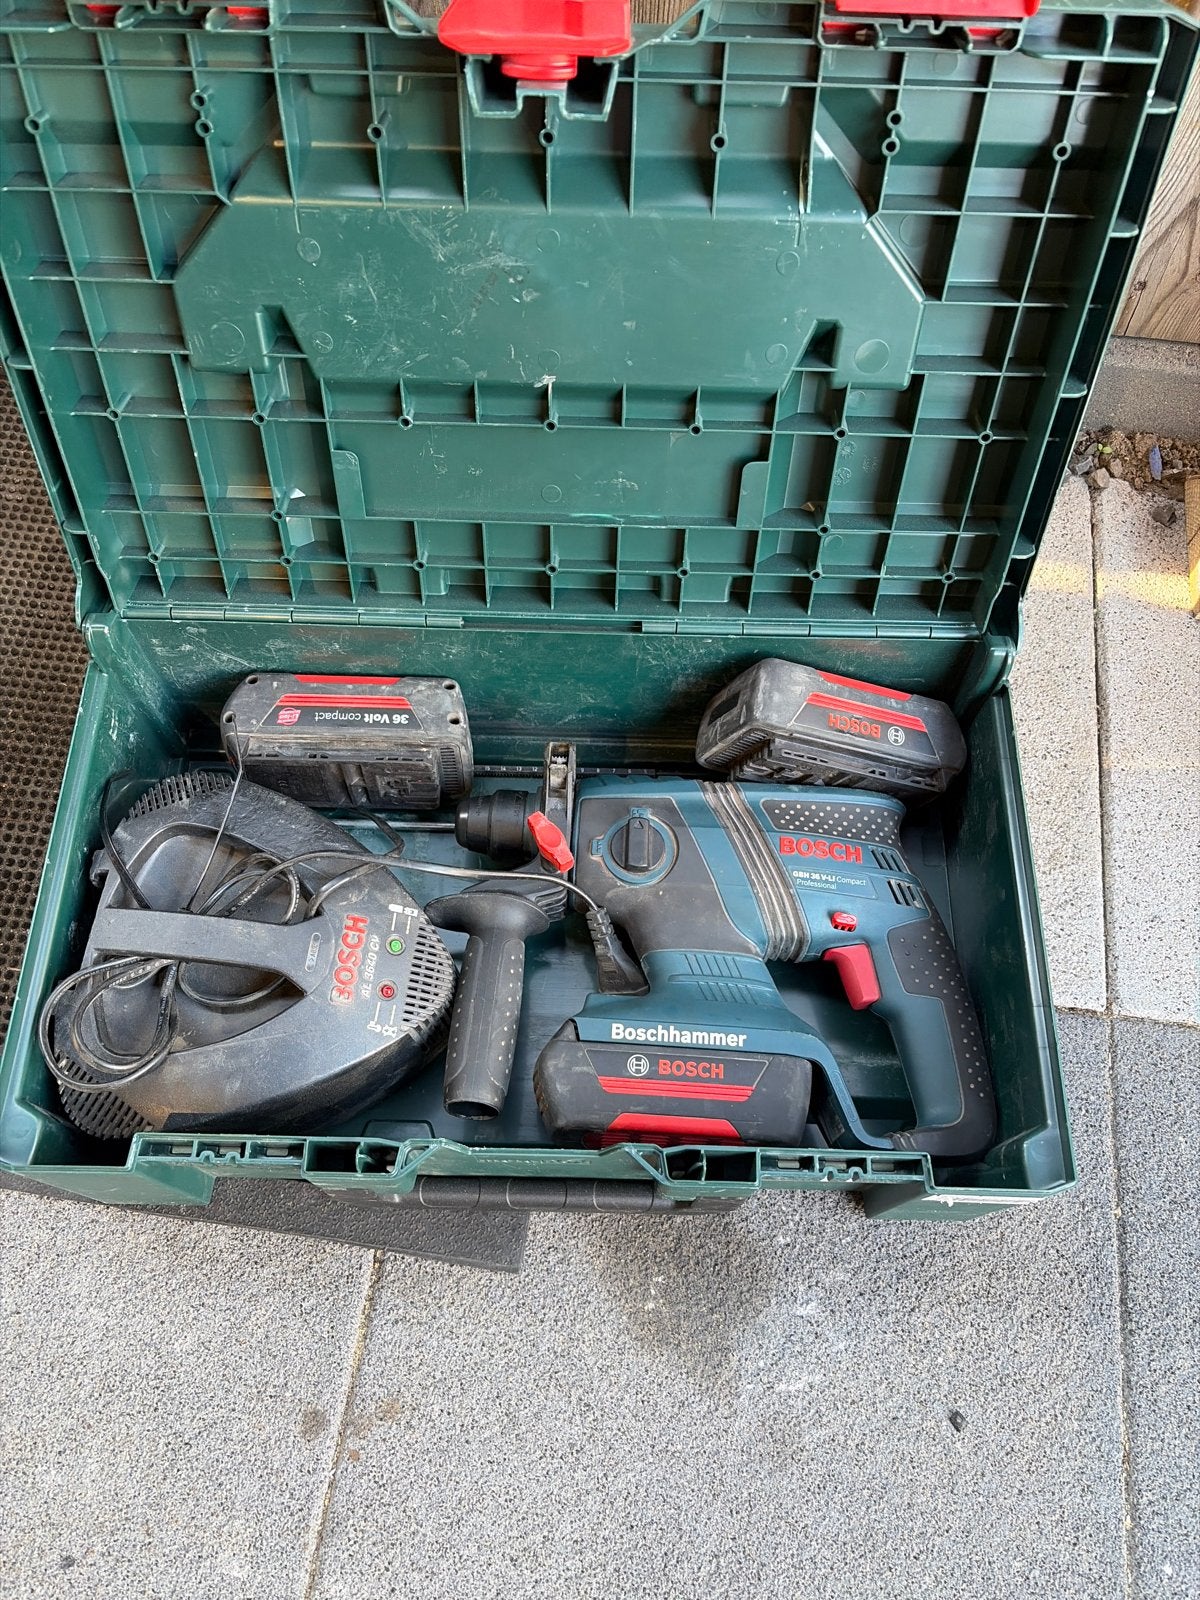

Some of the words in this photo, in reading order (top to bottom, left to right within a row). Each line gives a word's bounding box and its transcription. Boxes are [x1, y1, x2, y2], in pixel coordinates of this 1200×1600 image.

[314, 710, 361, 721] compact
[363, 713, 390, 724] Volt
[393, 713, 410, 724] 36
[828, 712, 881, 738] BOSCH
[779, 836, 863, 864] BOSCH
[792, 870, 810, 879] GBH
[836, 876, 866, 886] Compact
[796, 878, 837, 889] Professional
[329, 914, 369, 1004] BOSCH
[363, 953, 378, 981] 3640
[611, 1023, 747, 1047] Boschhammer
[657, 1059, 725, 1079] BOSCH
